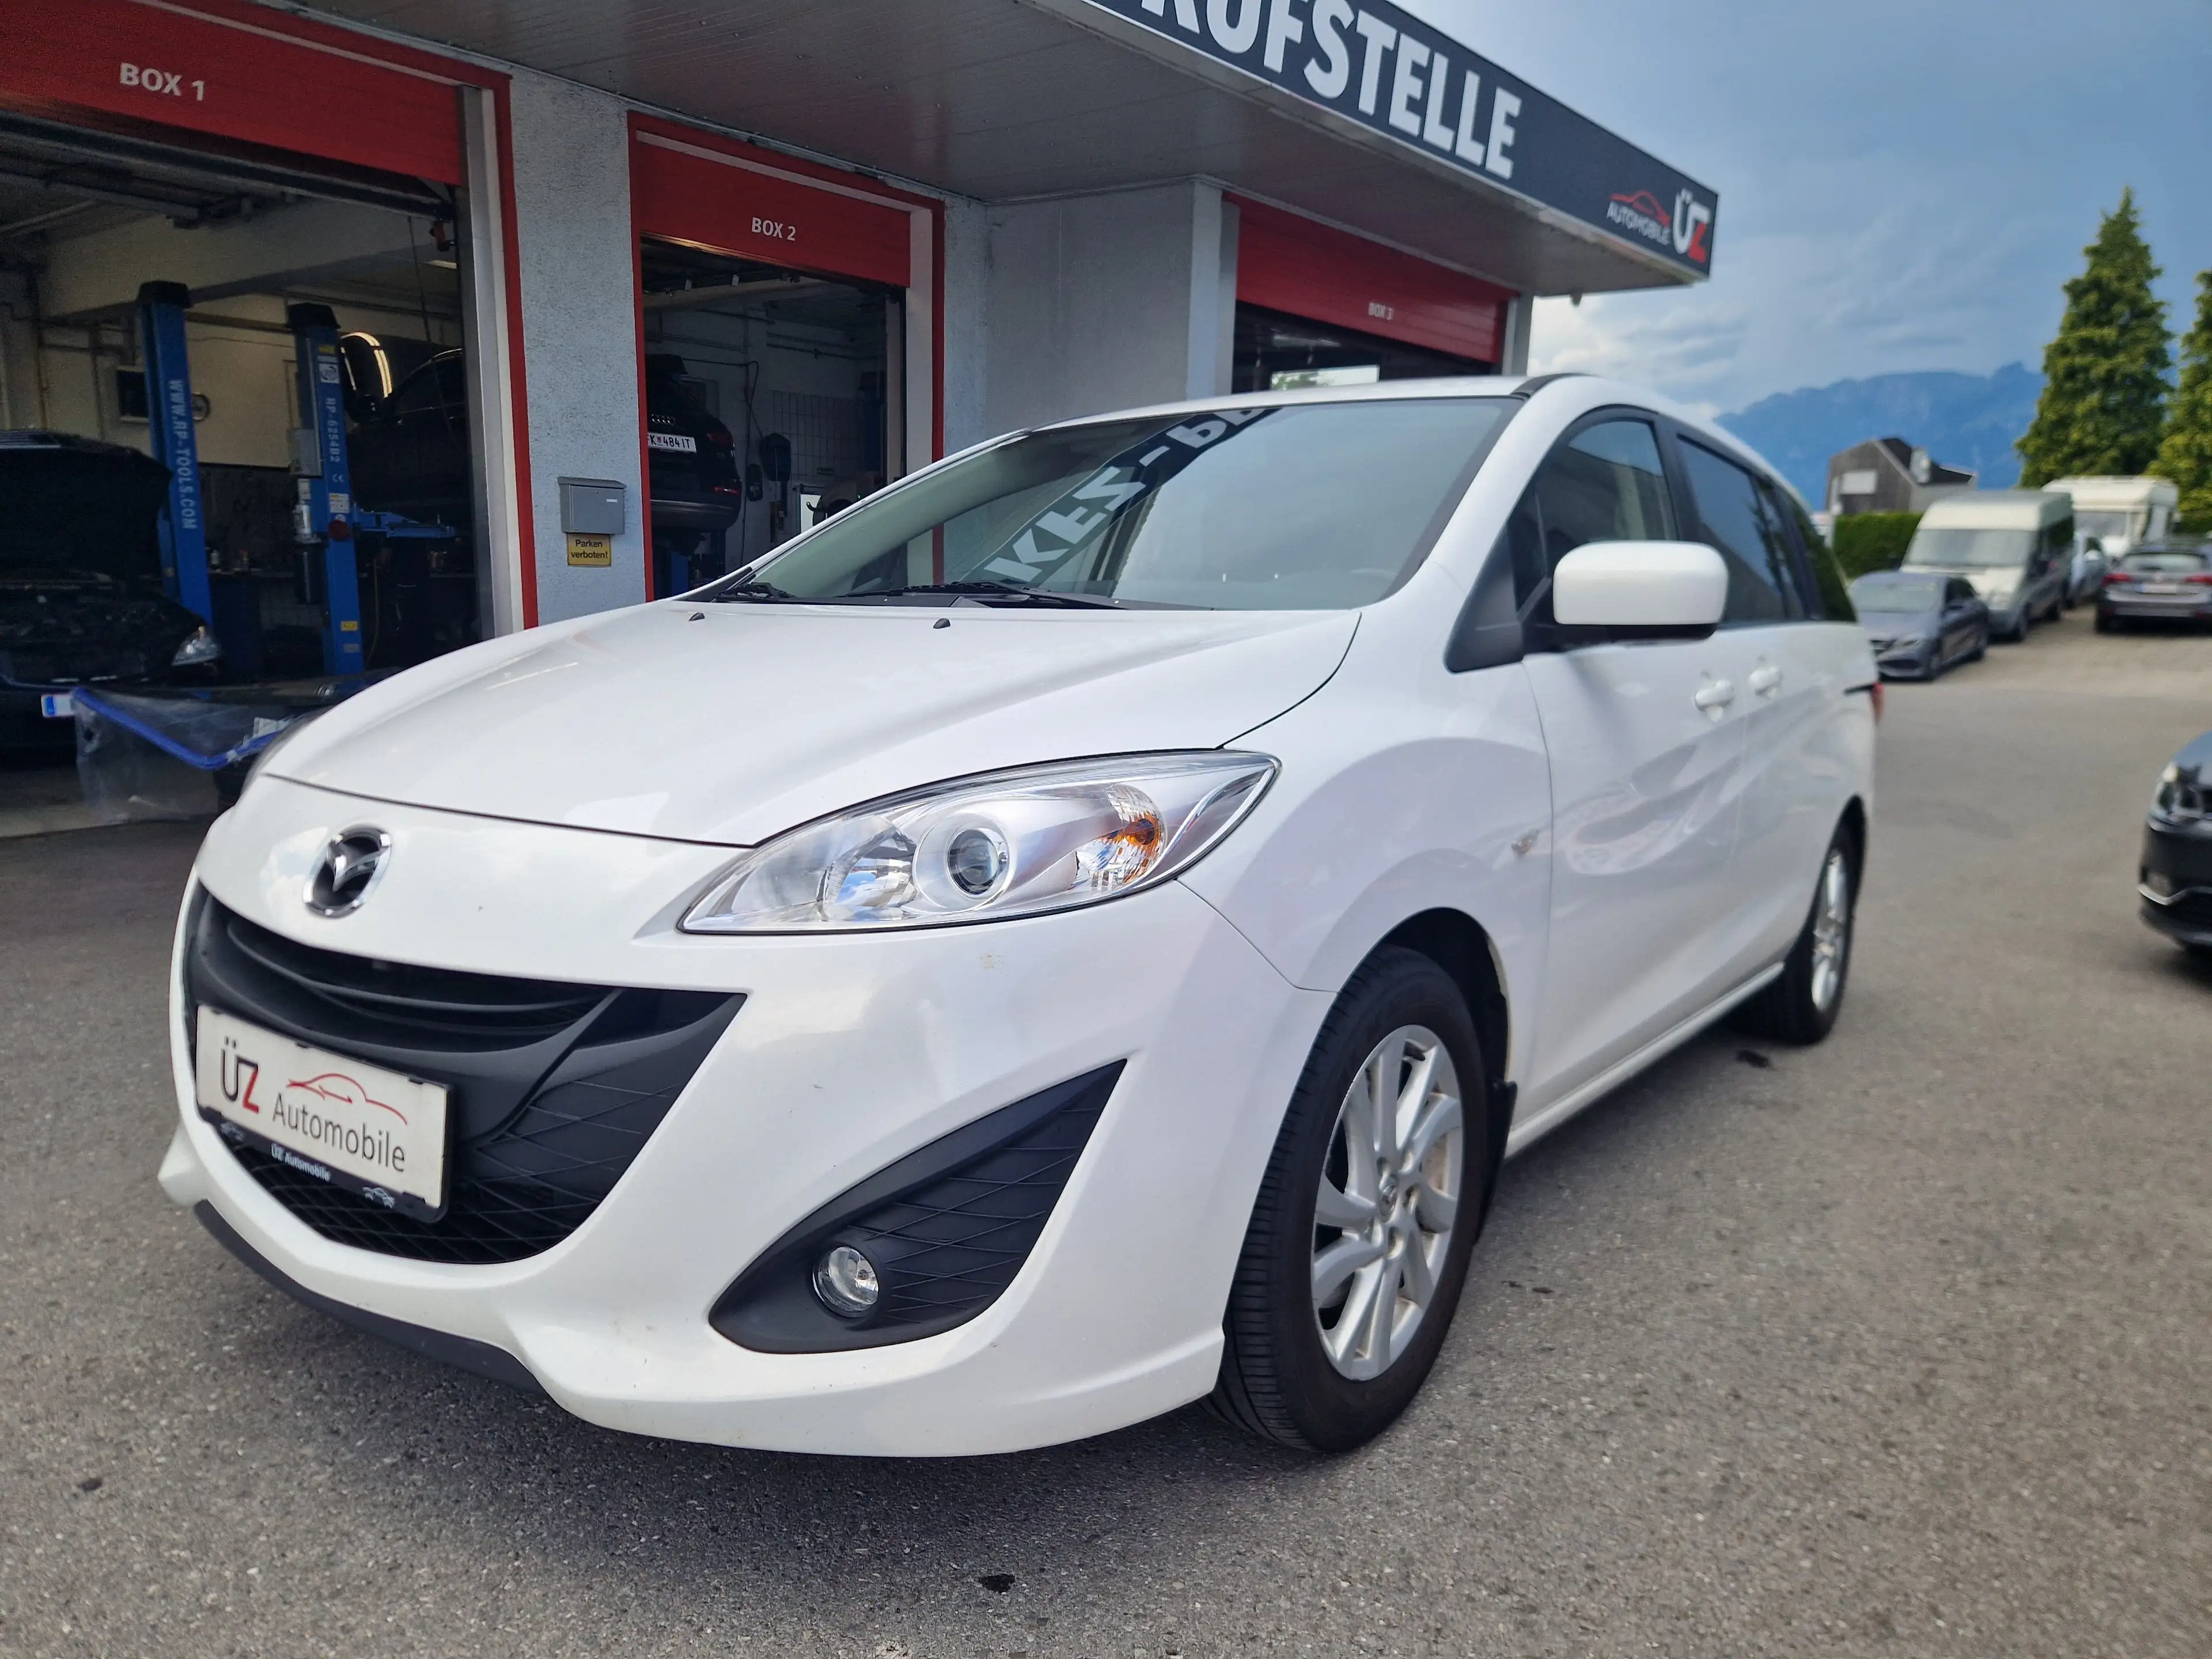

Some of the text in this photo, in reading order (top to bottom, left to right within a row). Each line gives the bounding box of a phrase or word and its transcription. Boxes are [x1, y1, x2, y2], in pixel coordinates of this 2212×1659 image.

[119, 62, 205, 101] BOX 1
[752, 217, 796, 241] BOX 2
[1673, 187, 1711, 263] ÜZ
[1368, 301, 1386, 319] BOX
[571, 551, 608, 559] verboten!
[575, 539, 603, 547] Parken
[221, 1036, 406, 1172] ÜZ Automobile
[271, 1142, 331, 1182] ÜZ Automobile
